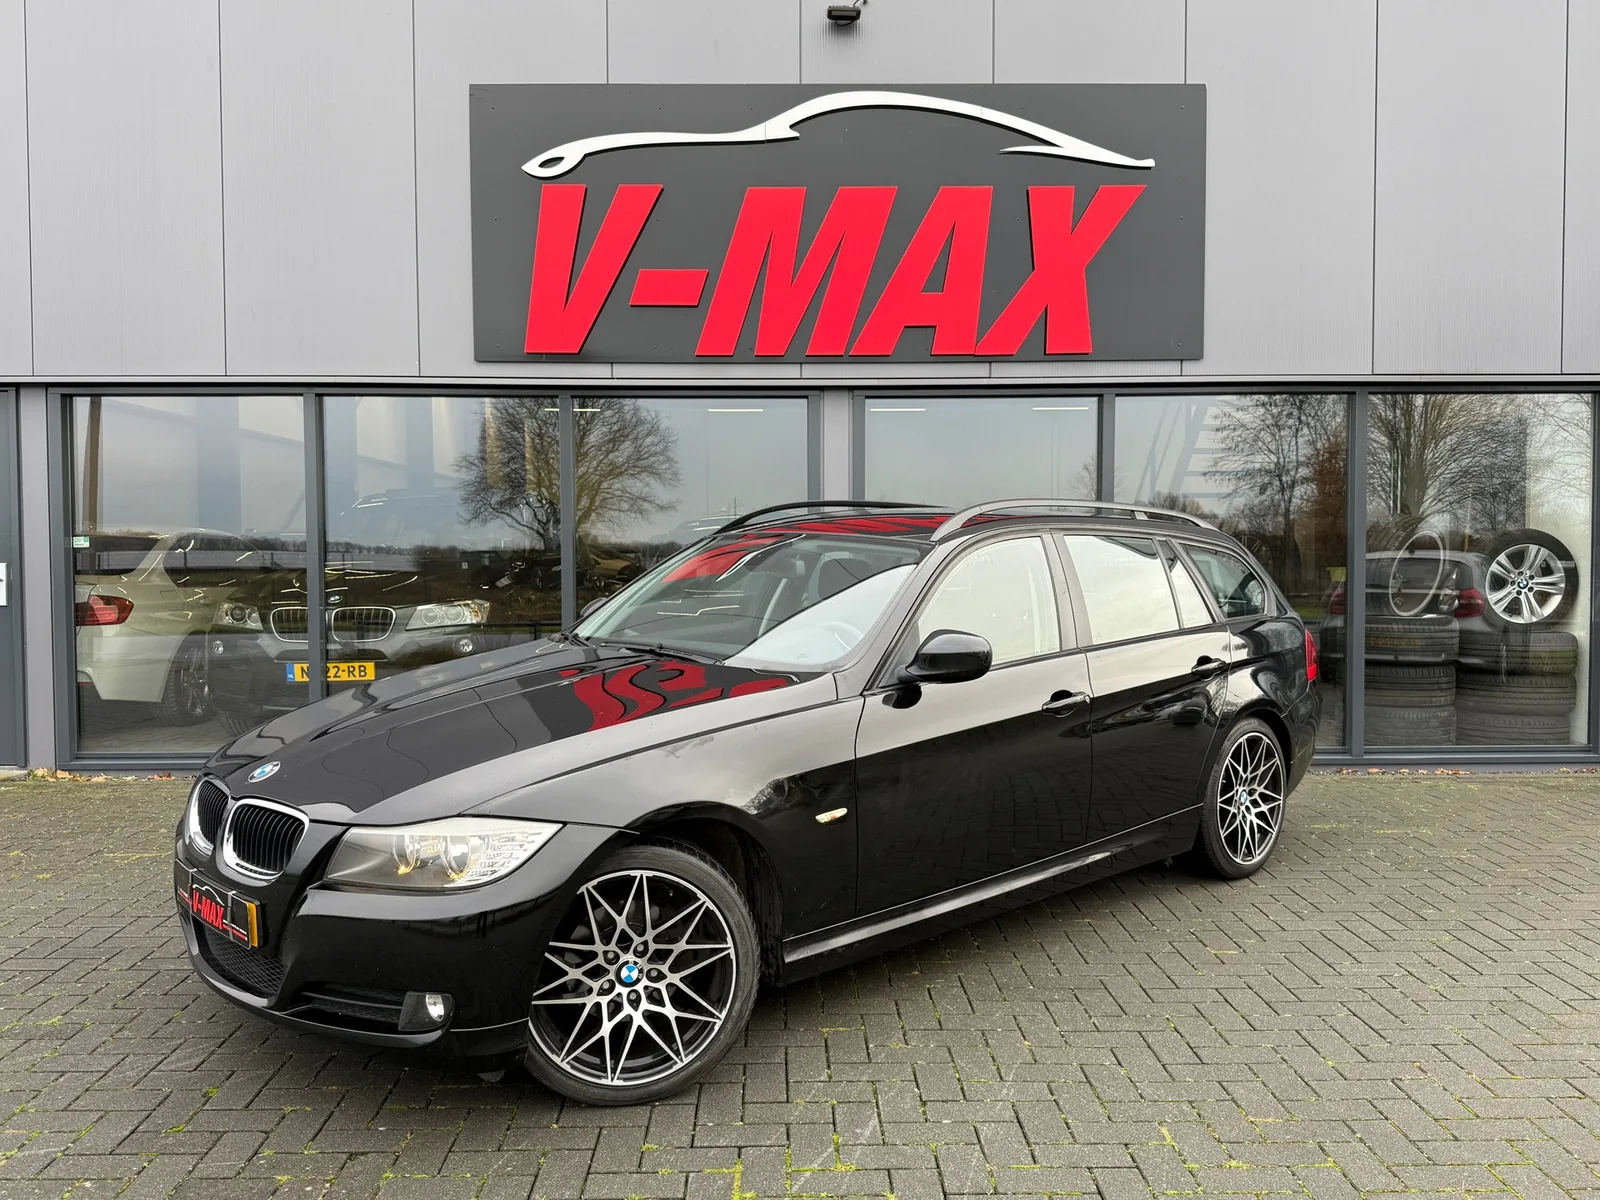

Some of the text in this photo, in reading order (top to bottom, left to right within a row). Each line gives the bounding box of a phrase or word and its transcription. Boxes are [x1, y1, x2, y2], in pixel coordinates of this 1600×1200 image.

[524, 183, 1147, 356] V-MAX
[300, 664, 368, 679] N22-RB
[192, 889, 225, 930] V-MAX
